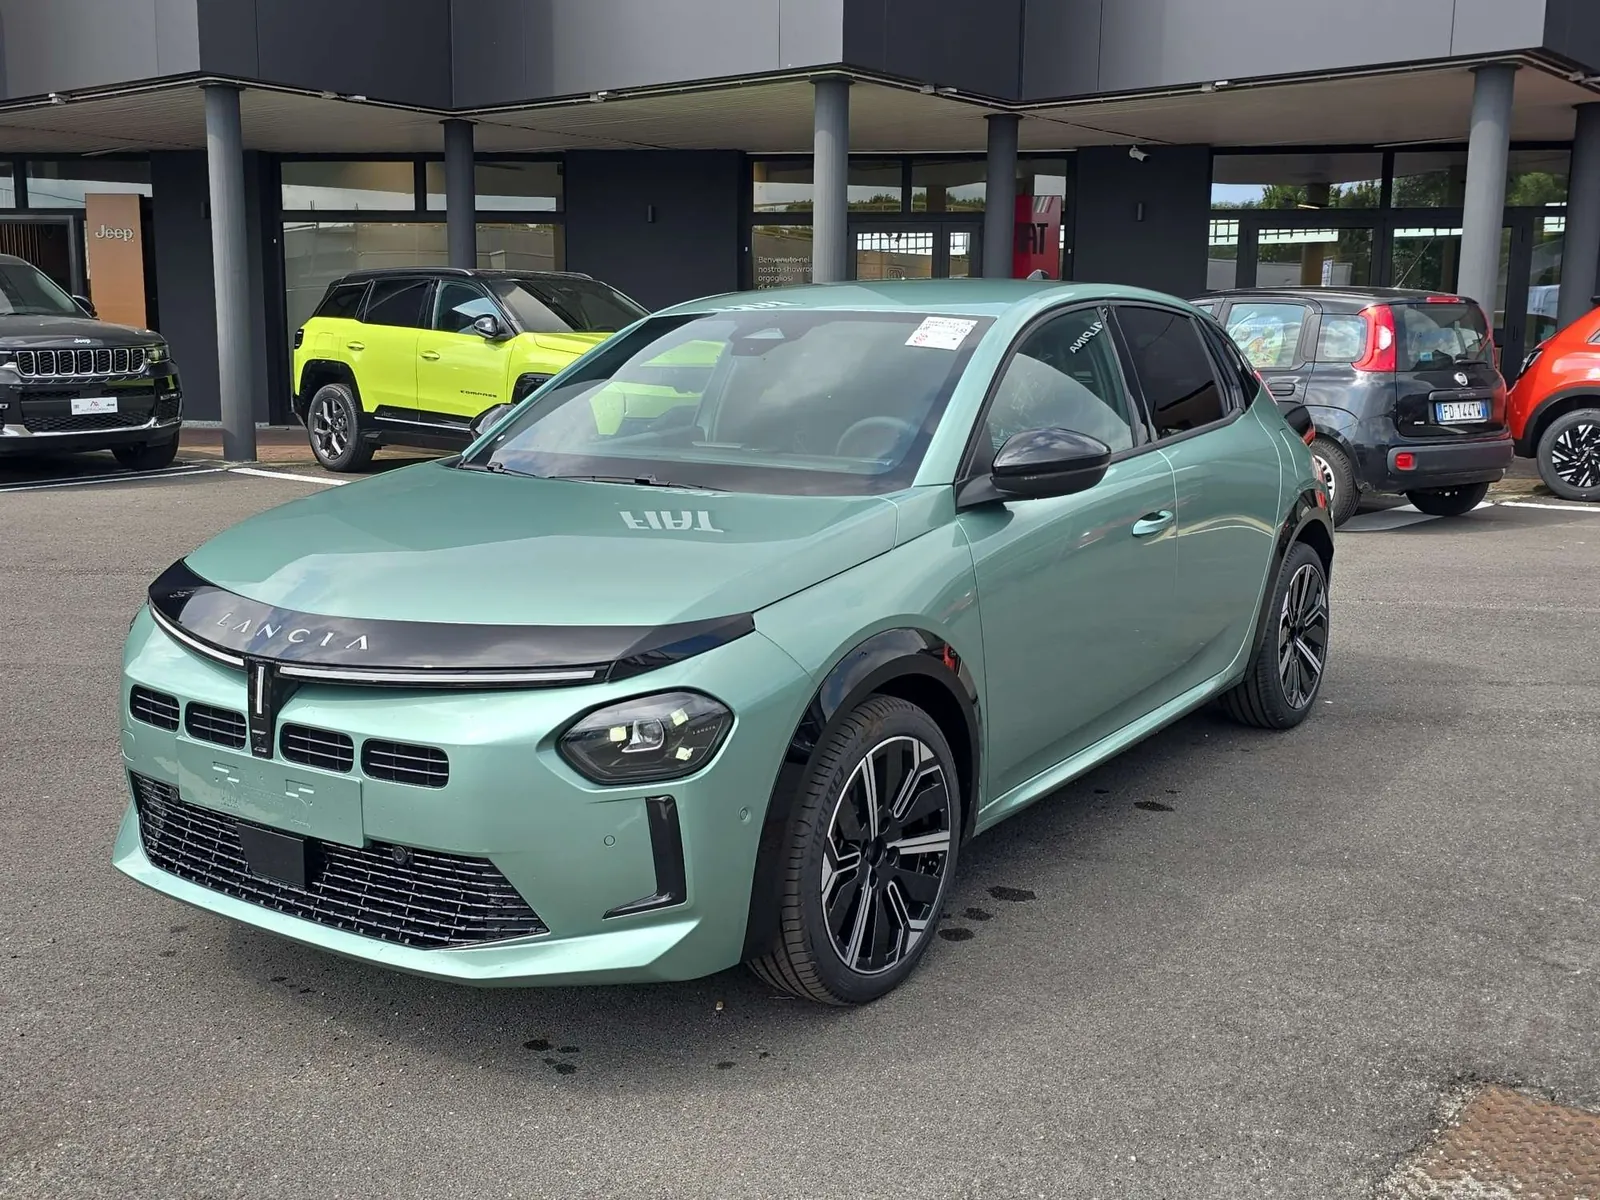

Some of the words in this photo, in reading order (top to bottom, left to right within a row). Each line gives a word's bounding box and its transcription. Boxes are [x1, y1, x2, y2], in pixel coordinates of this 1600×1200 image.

[95, 224, 134, 241] Jeep
[758, 256, 797, 264] Benvenuto
[758, 265, 782, 273] nostro
[758, 274, 794, 283] orgogliosi
[1443, 404, 1454, 418] FD
[216, 612, 370, 651] LANCIA
